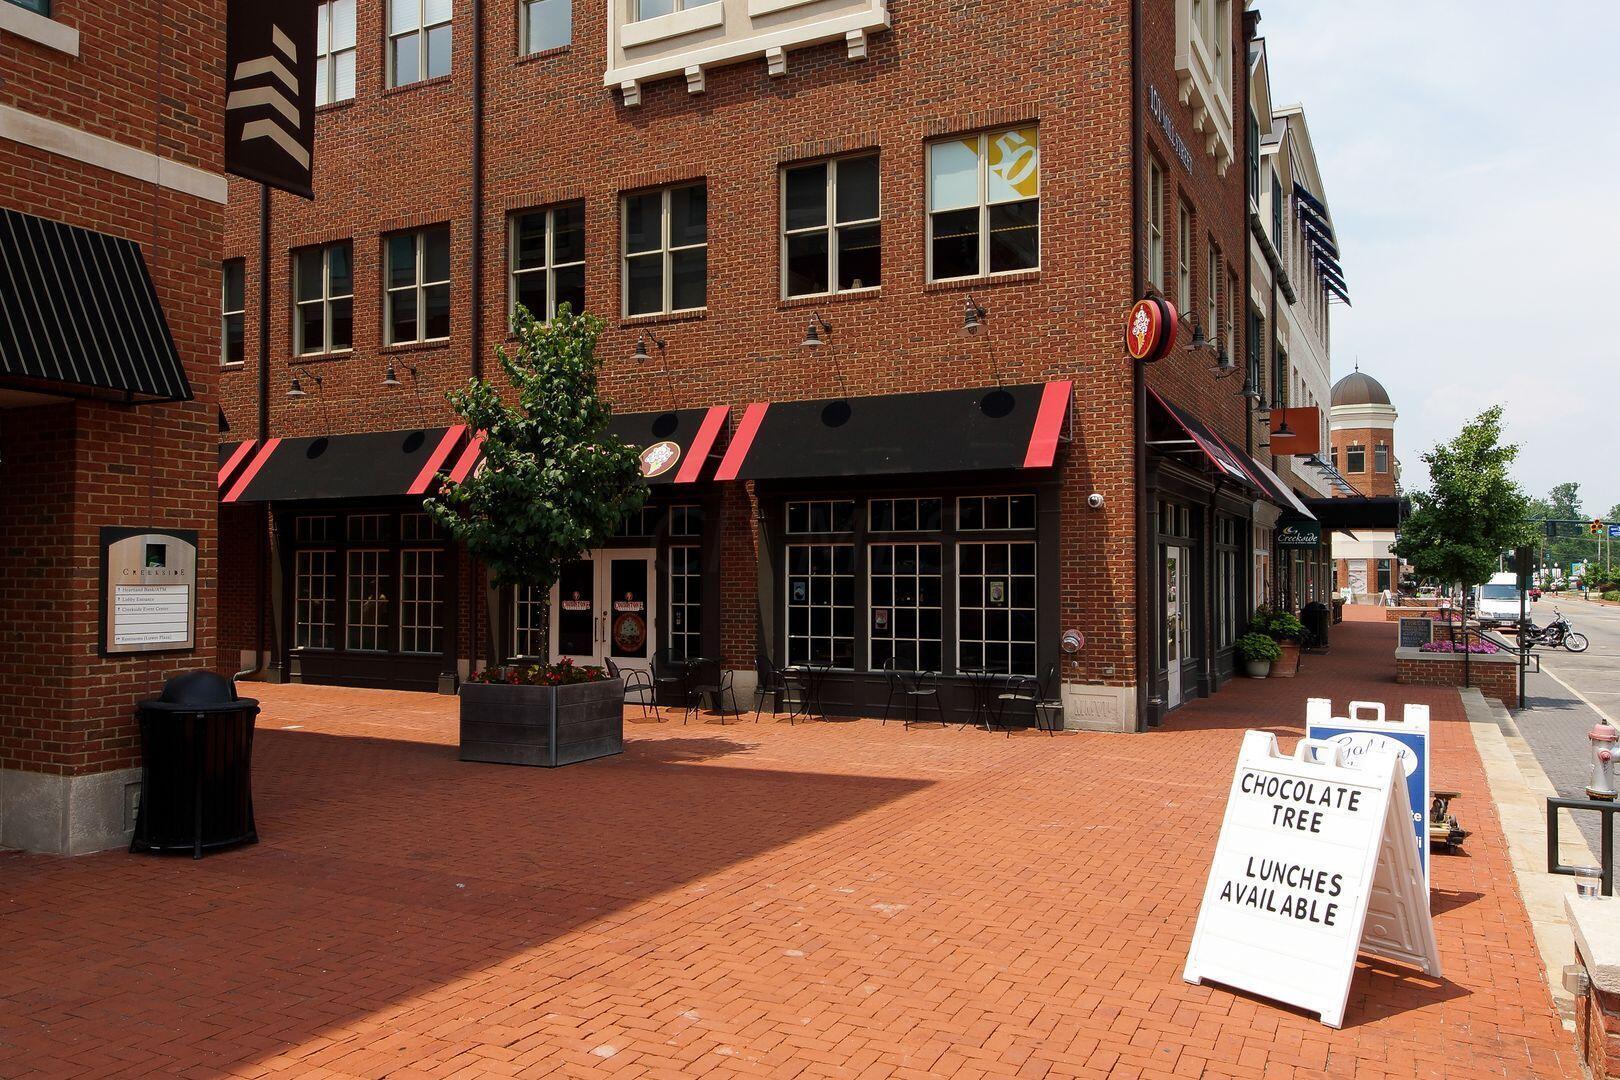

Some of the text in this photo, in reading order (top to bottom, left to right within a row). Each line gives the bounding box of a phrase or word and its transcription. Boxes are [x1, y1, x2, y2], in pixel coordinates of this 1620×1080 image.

[1277, 532, 1318, 541] Creekside
[1241, 772, 1362, 812] CHOCOLATE
[1273, 804, 1324, 834] TREE
[1246, 856, 1343, 897] LUNCHES
[1220, 880, 1338, 927] AVAILABLE
